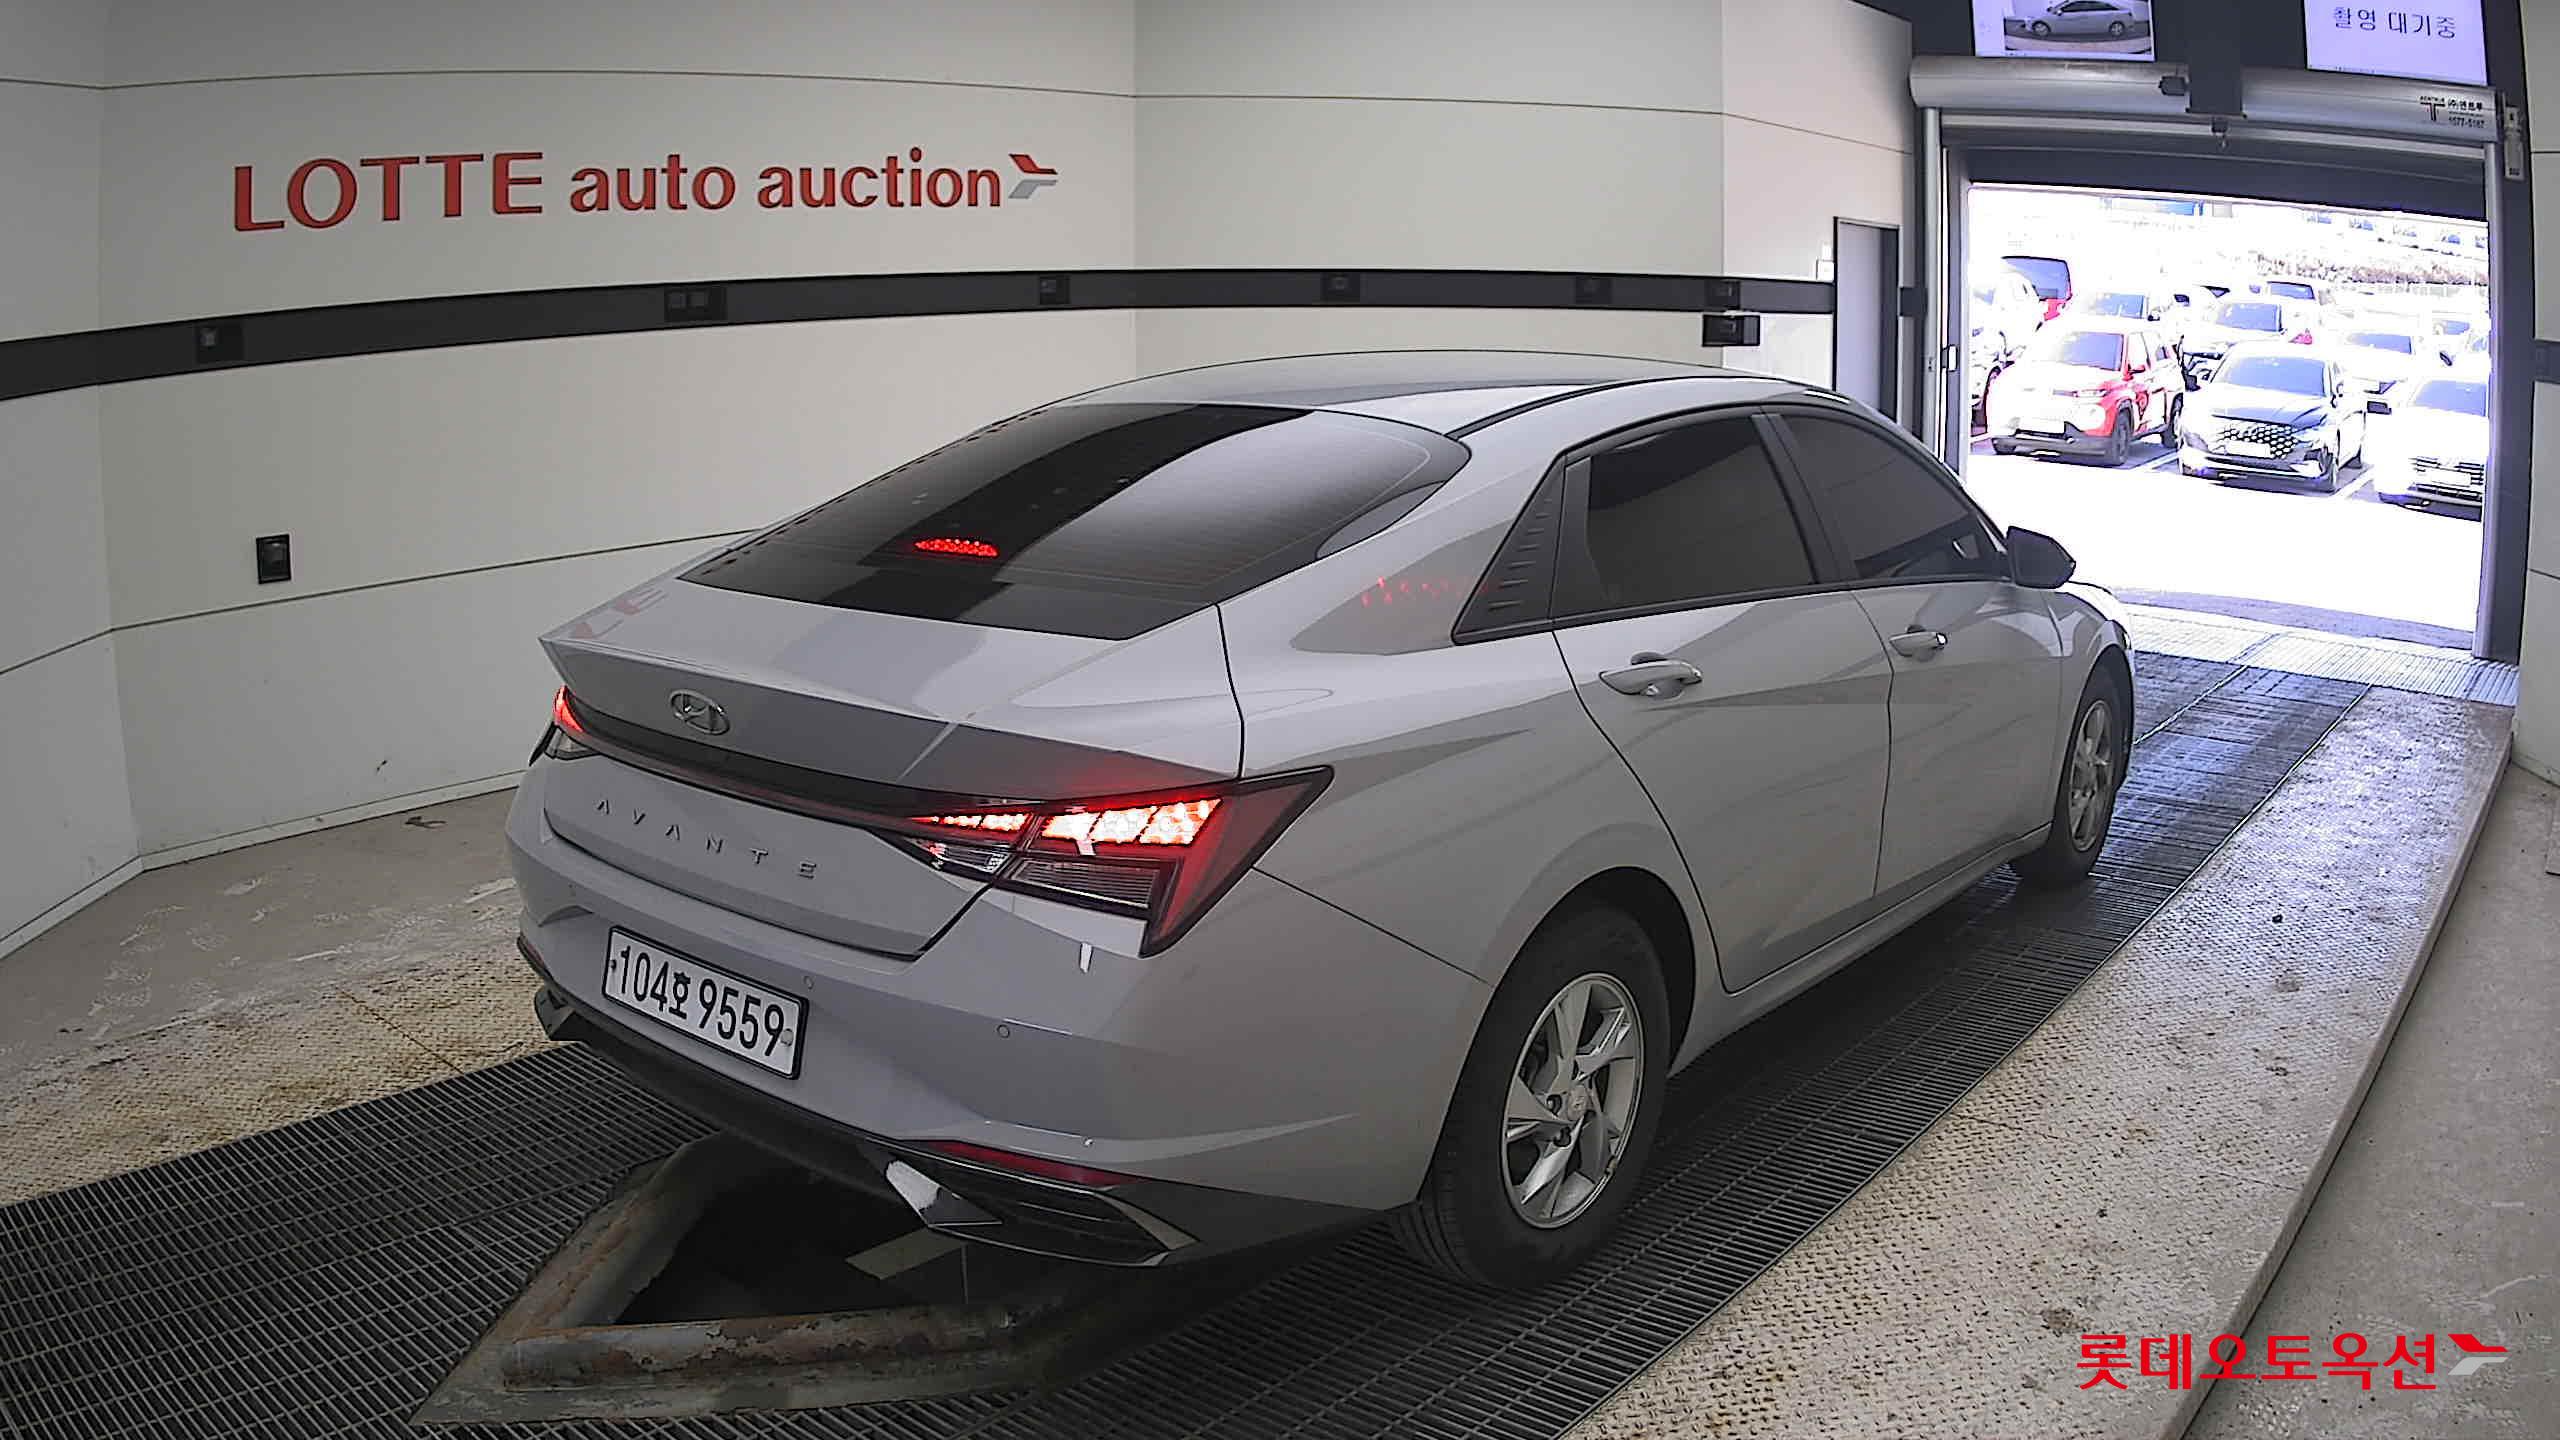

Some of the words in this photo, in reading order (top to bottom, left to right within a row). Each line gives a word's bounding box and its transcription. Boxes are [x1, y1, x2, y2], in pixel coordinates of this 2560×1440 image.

[2388, 11, 2456, 39] 대기중
[234, 152, 543, 232] LOTTE
[569, 153, 736, 213] auto
[757, 147, 1001, 211] auction
[596, 799, 818, 880] AVANTE
